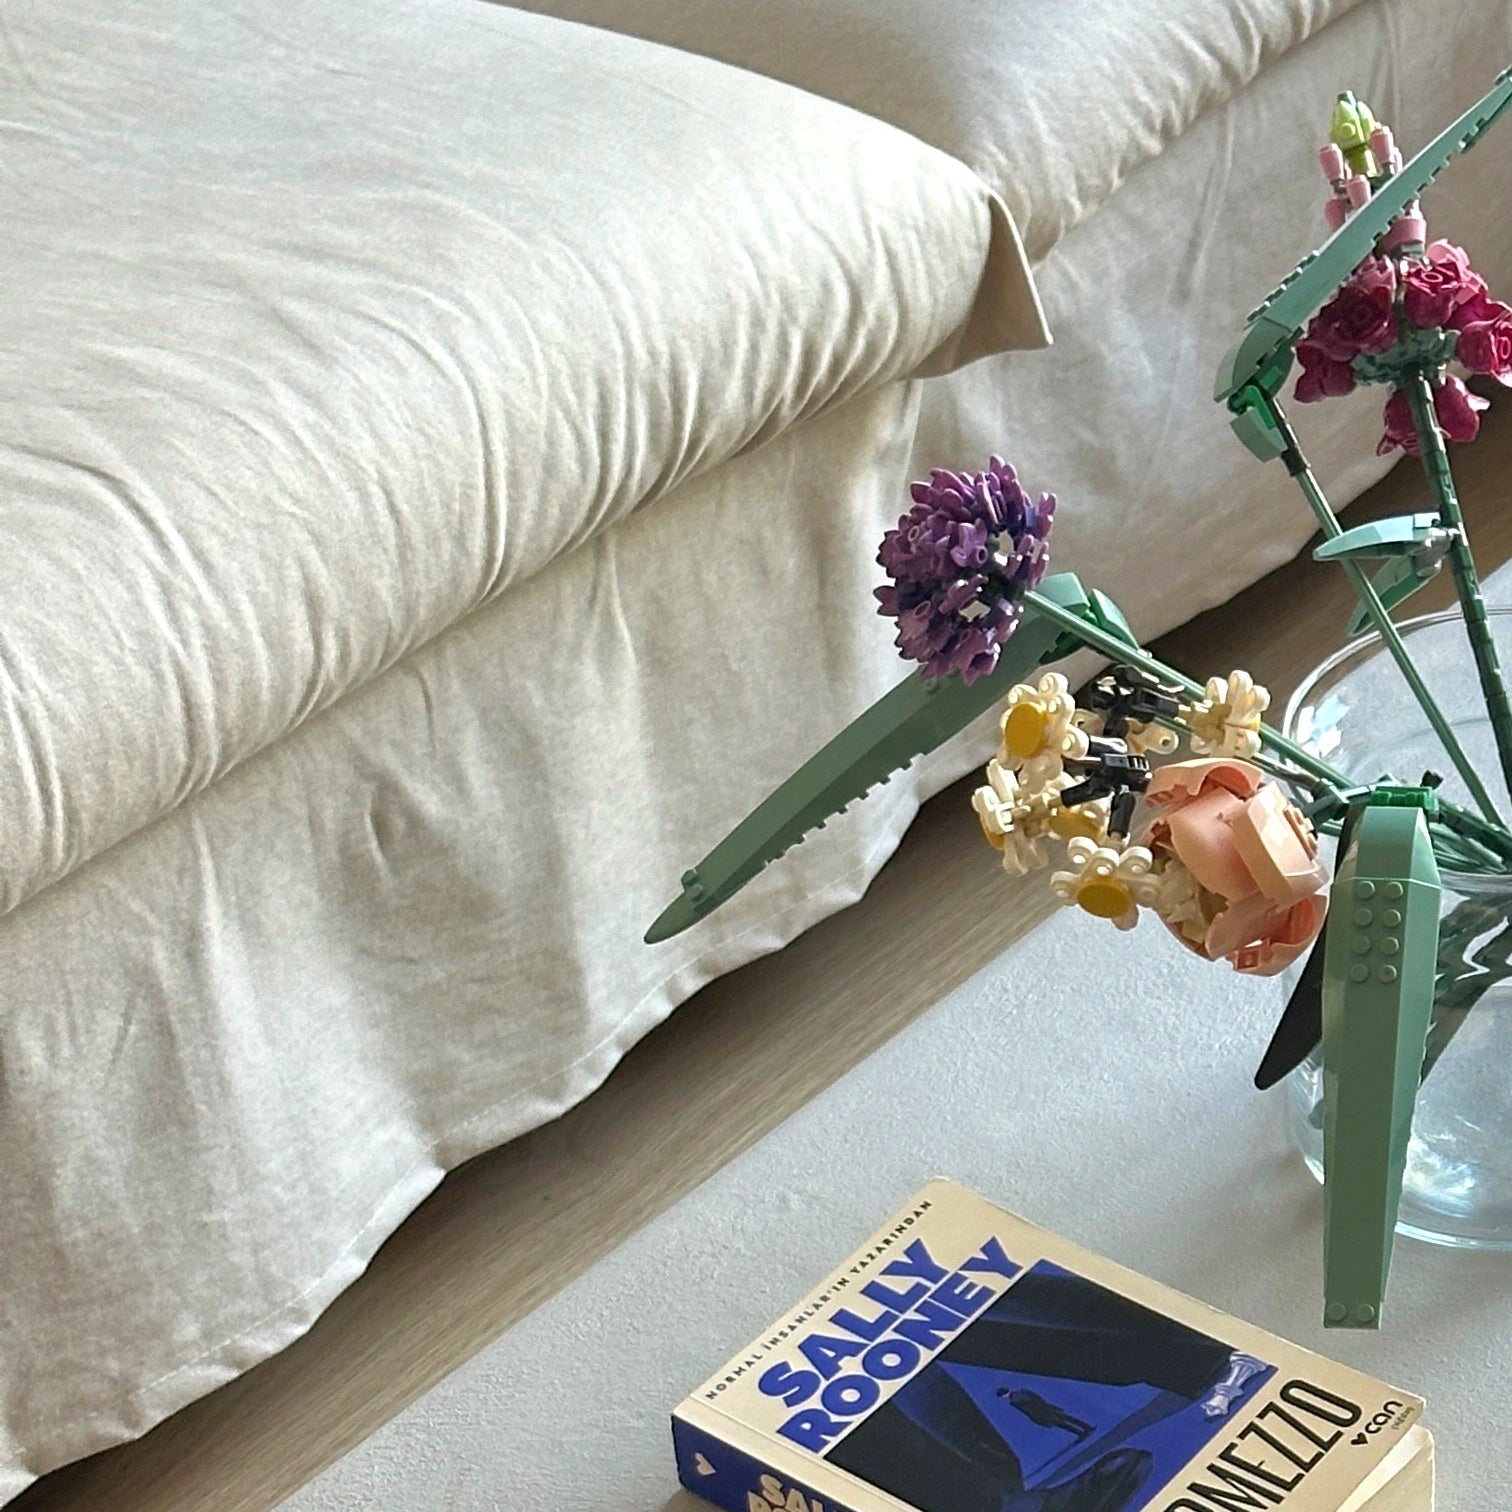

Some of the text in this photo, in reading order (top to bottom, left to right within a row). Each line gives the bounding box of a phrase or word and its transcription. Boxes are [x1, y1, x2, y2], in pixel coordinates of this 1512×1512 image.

[705, 1200, 933, 1401] NORMAL İNSANLAR'IN YAZARINDAN
[758, 1238, 949, 1408] SALLY
[775, 1236, 1023, 1454] ROONEY
[1365, 1401, 1403, 1434] can
